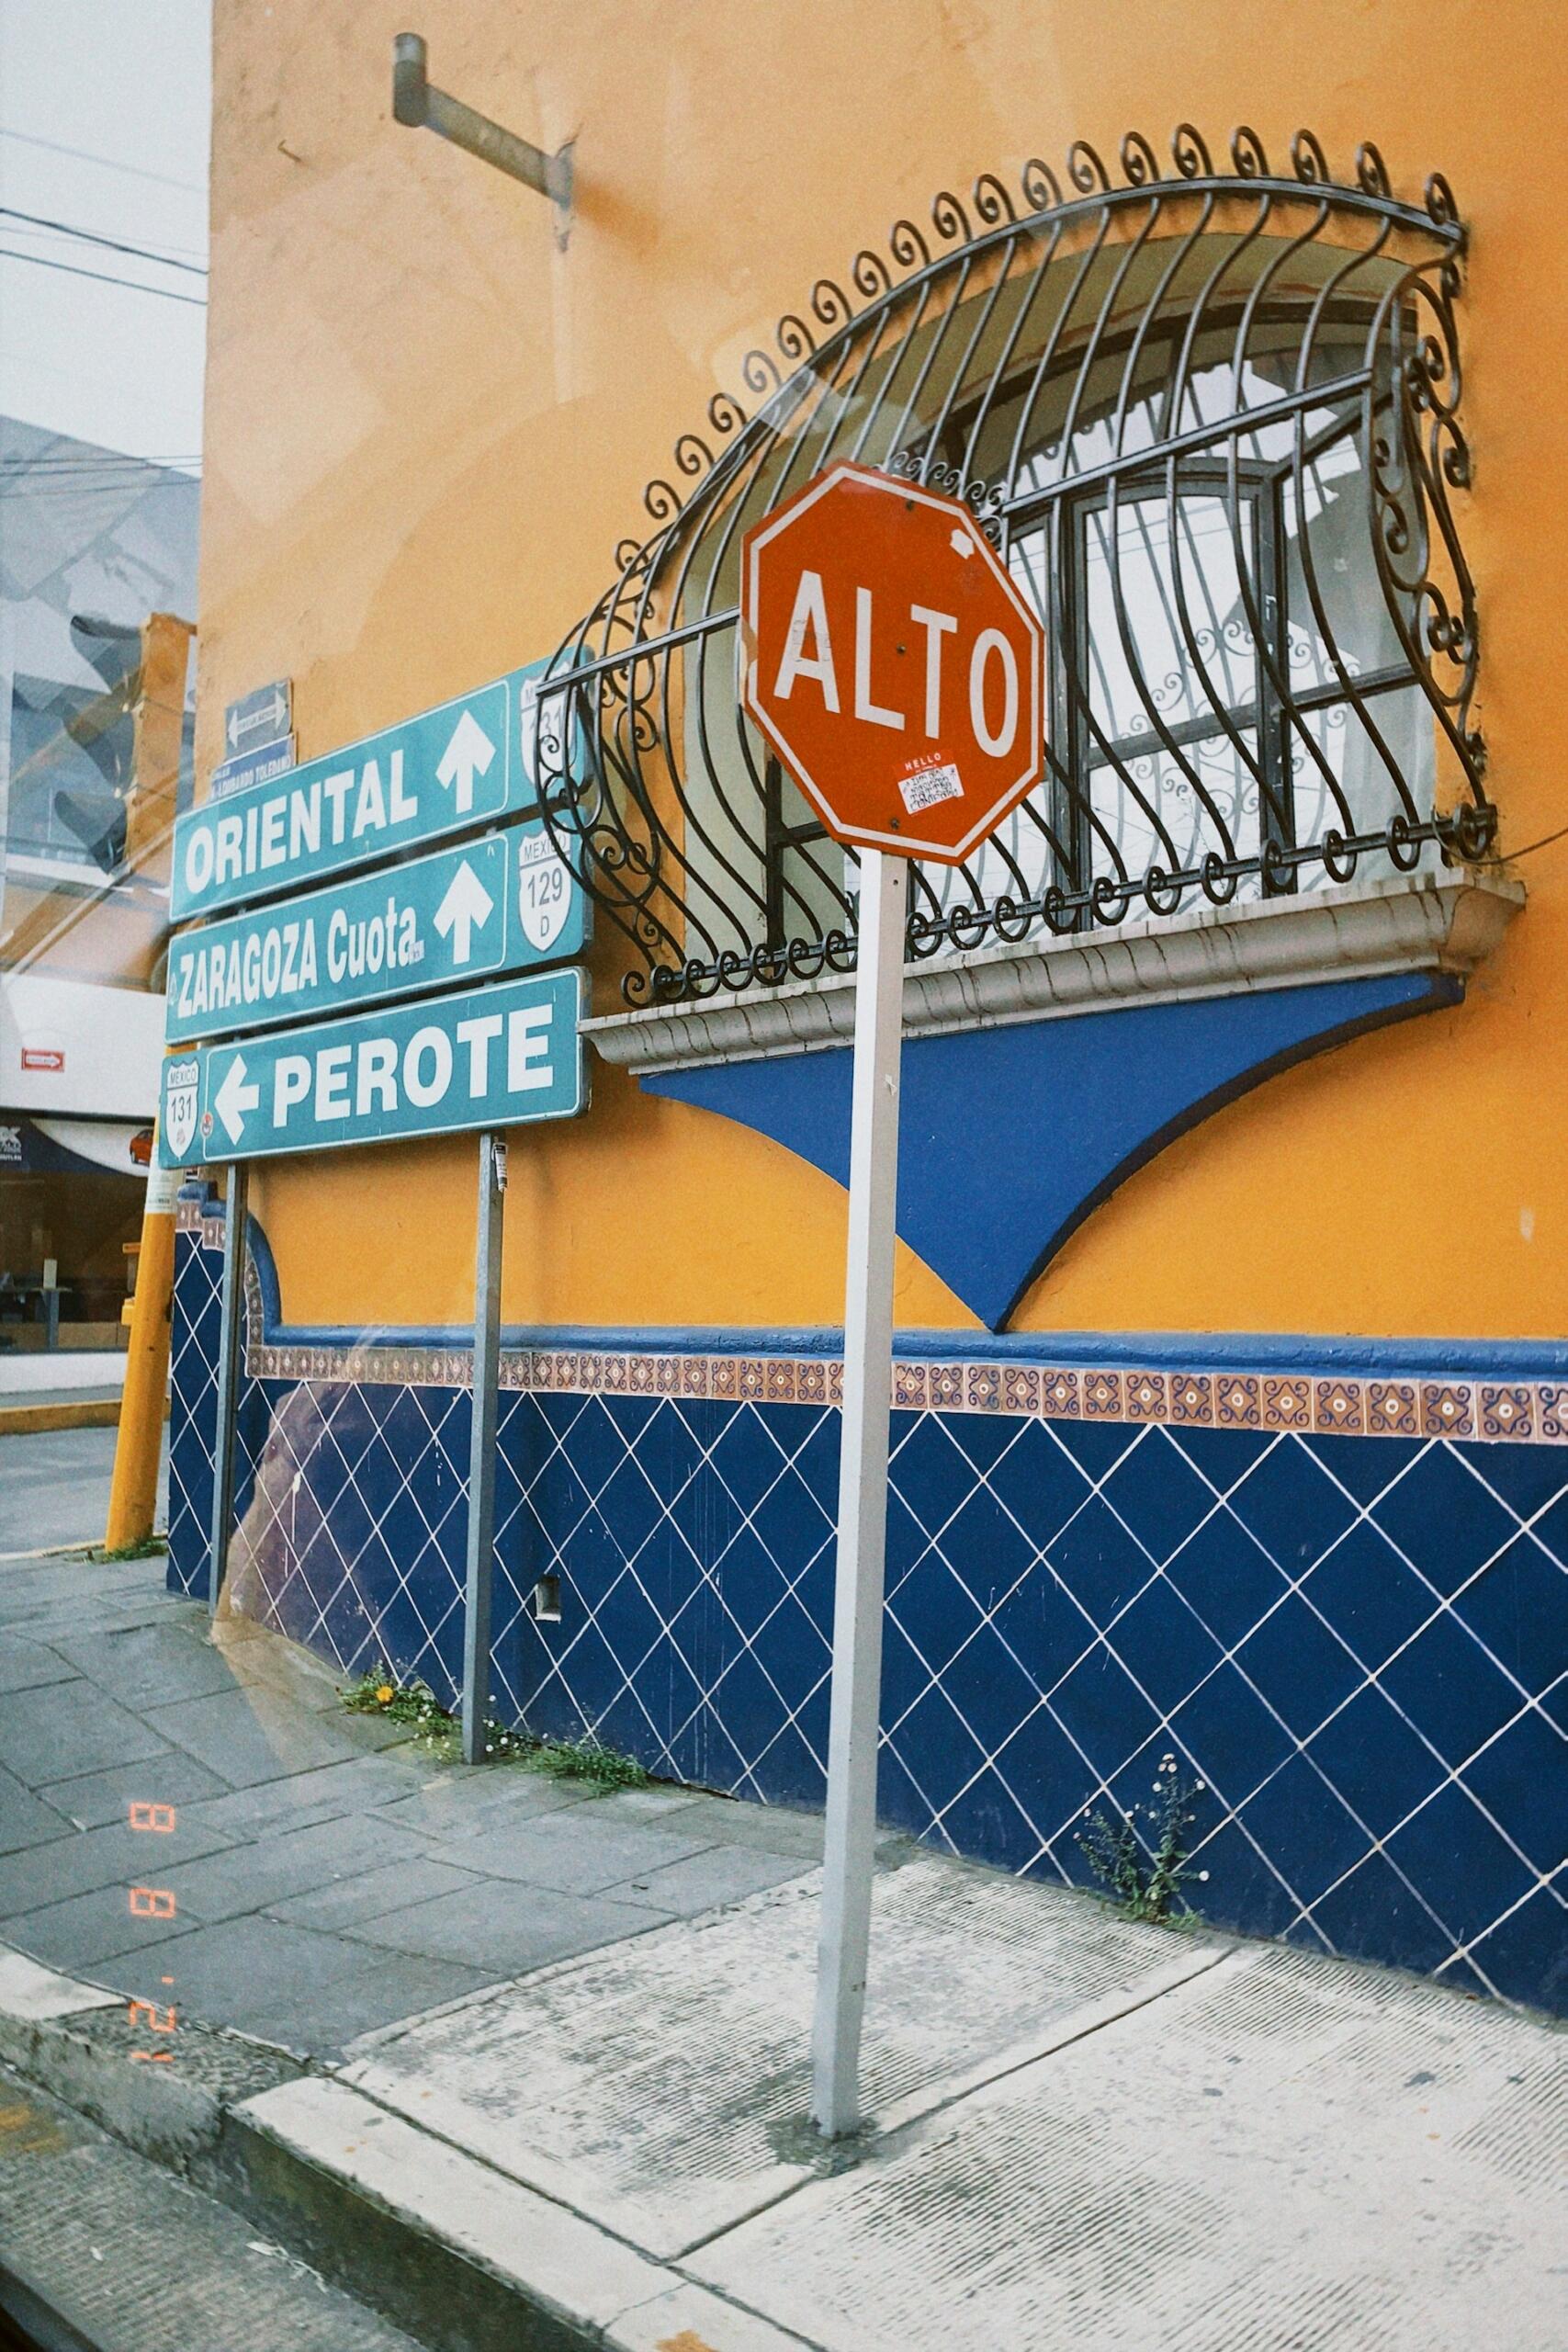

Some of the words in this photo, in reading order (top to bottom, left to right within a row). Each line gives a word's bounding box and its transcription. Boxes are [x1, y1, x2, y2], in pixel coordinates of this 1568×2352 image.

[773, 570, 1019, 758] ALTO
[905, 752, 942, 772] HELLO
[186, 749, 418, 895] ORIENTAL
[525, 832, 567, 862] MEXIO
[527, 867, 563, 909] 129
[540, 915, 550, 937] D
[177, 918, 318, 1019] ZARAGOZA
[327, 897, 417, 984] Cuota
[170, 1068, 197, 1085] MEXICO
[273, 1003, 553, 1128] PEROTE
[171, 1094, 192, 1124] 131
